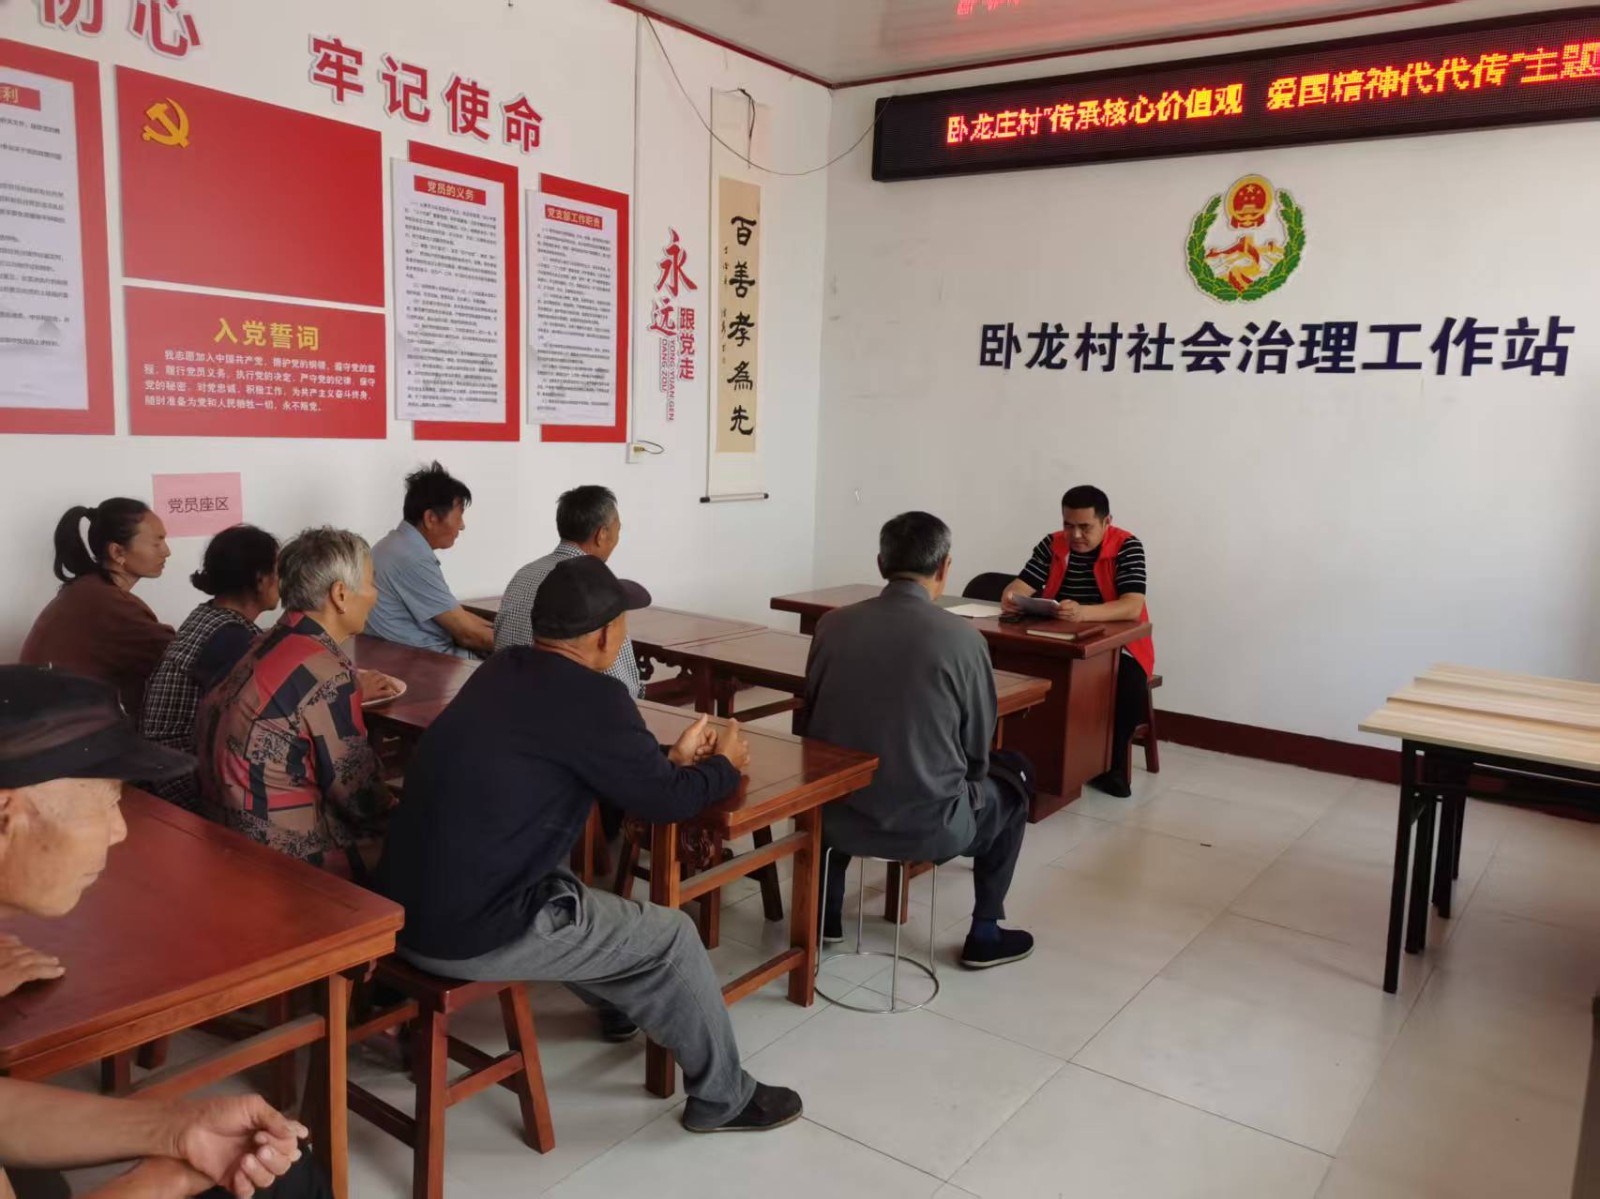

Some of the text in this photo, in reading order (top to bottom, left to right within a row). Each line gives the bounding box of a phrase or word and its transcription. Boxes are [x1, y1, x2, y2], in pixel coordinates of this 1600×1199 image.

[312, 37, 543, 153] 牢记使命
[427, 180, 474, 201] 党员的义务
[213, 317, 319, 351] 入党誓词
[679, 307, 695, 380] 跟党走
[979, 316, 1575, 377] 卧龙村社会治理工作站
[167, 496, 229, 514] 党员座区
